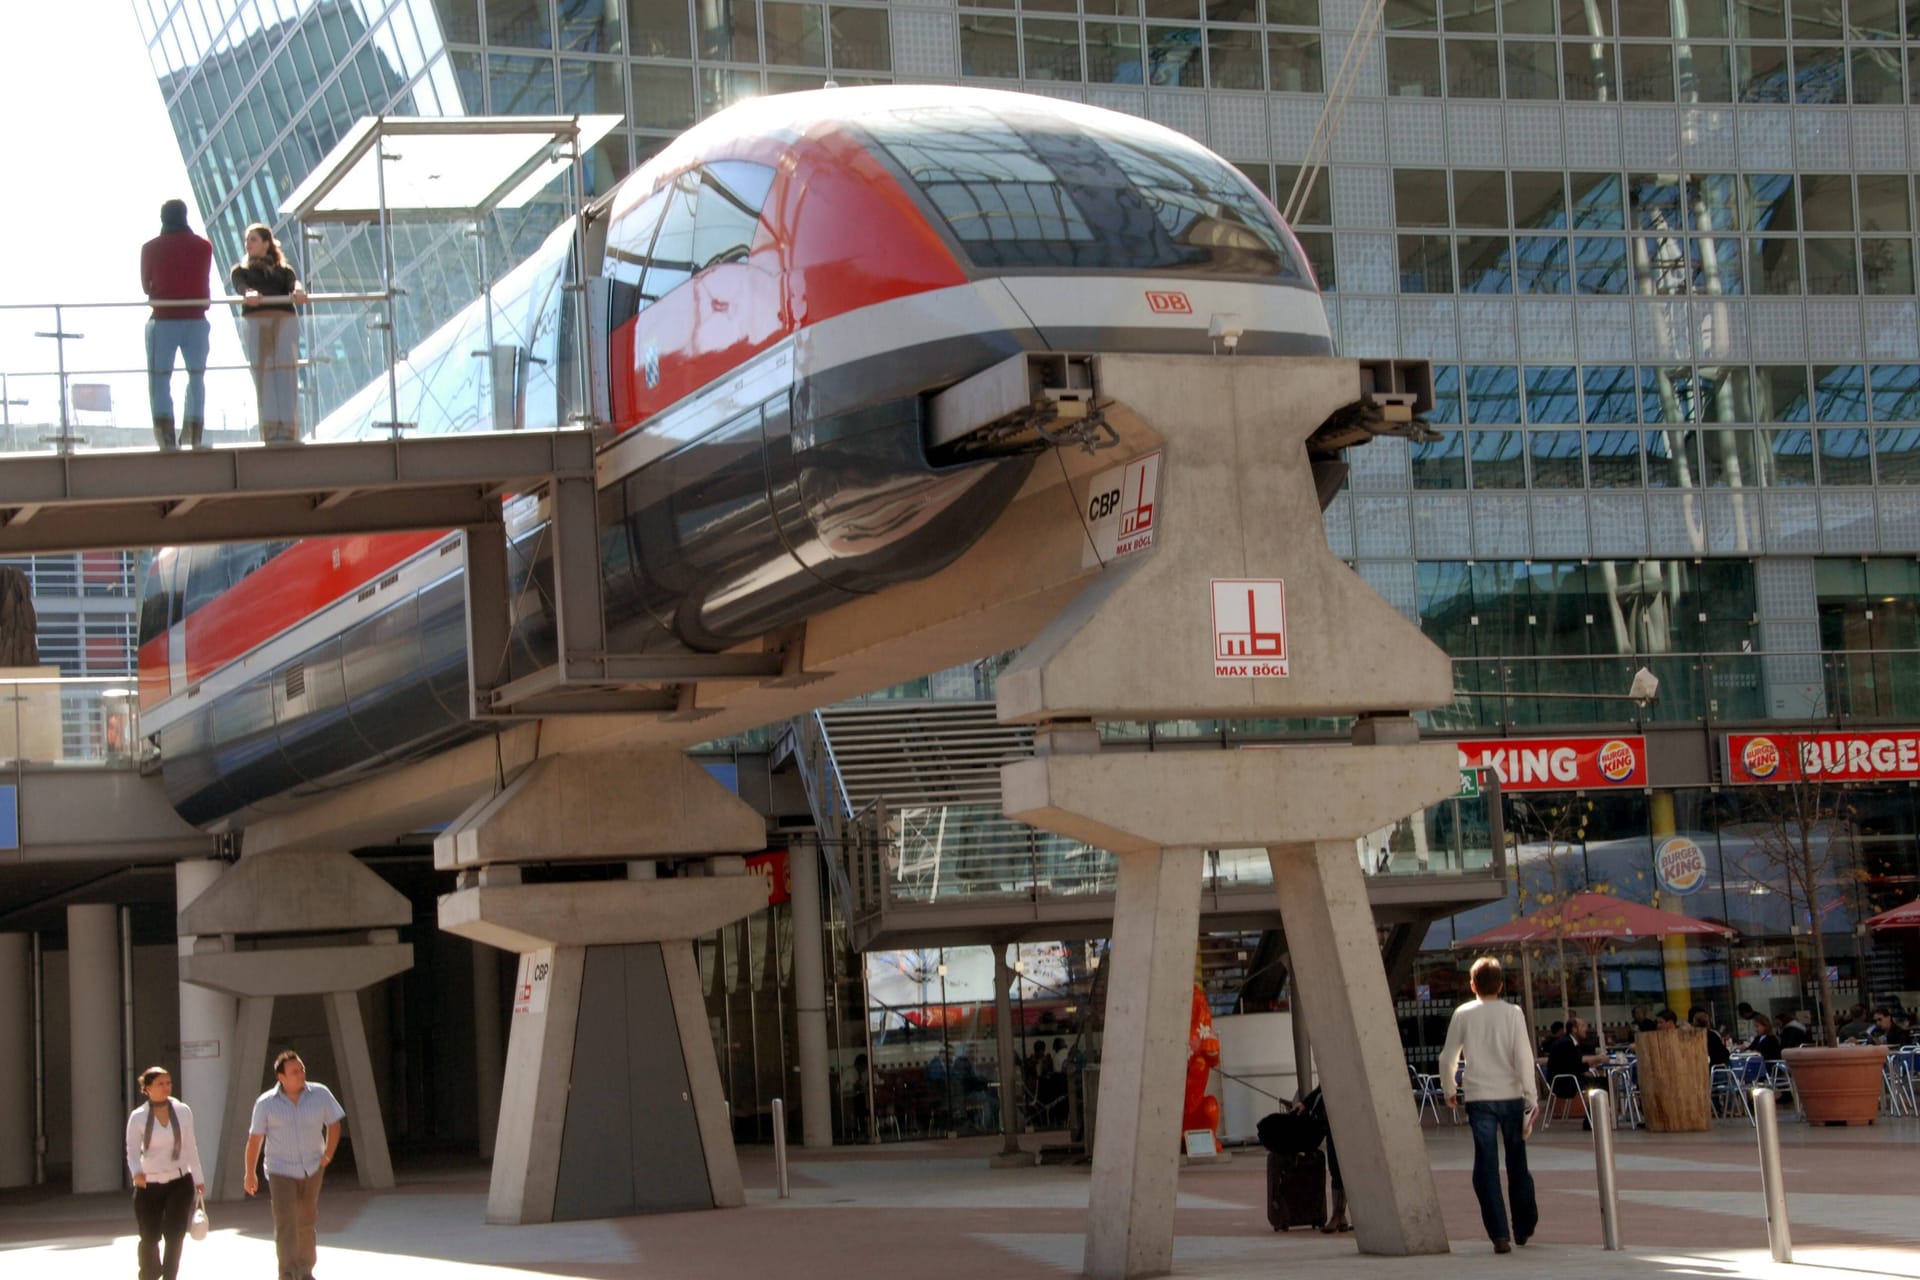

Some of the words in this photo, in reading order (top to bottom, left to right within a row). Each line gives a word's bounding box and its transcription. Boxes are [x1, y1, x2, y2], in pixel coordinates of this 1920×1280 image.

[1151, 294, 1187, 310] DB
[1089, 489, 1121, 522] CBP
[1116, 543, 1132, 554] MAX
[1216, 666, 1247, 676] MAX
[1252, 663, 1288, 676] BÖGL
[1602, 747, 1630, 763] BURGER
[1603, 755, 1632, 773] KING
[1799, 738, 1920, 774] BURGE
[1480, 746, 1577, 784] KING
[1661, 847, 1698, 868] BURGER
[1664, 856, 1702, 882] KING
[534, 963, 549, 981] CBP
